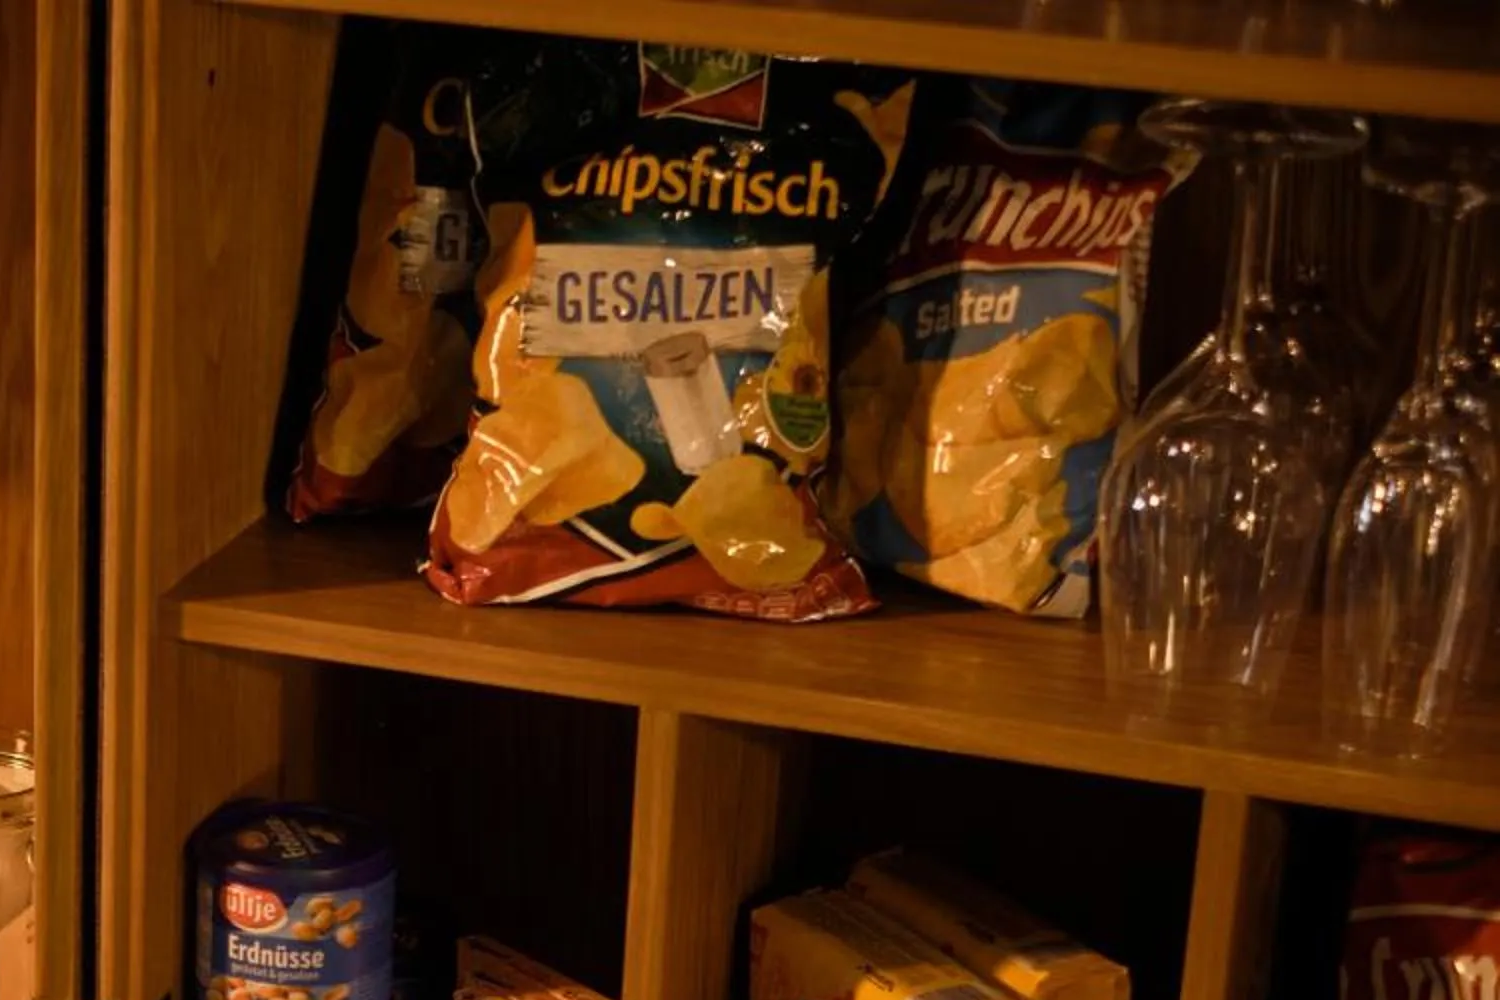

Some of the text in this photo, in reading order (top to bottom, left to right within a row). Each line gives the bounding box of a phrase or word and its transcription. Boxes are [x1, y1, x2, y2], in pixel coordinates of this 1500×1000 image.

[540, 144, 840, 221] Chipsfrisch
[897, 164, 1157, 258] runchips
[556, 268, 774, 324] GESALZEN
[227, 933, 325, 970] Erdnüsse
